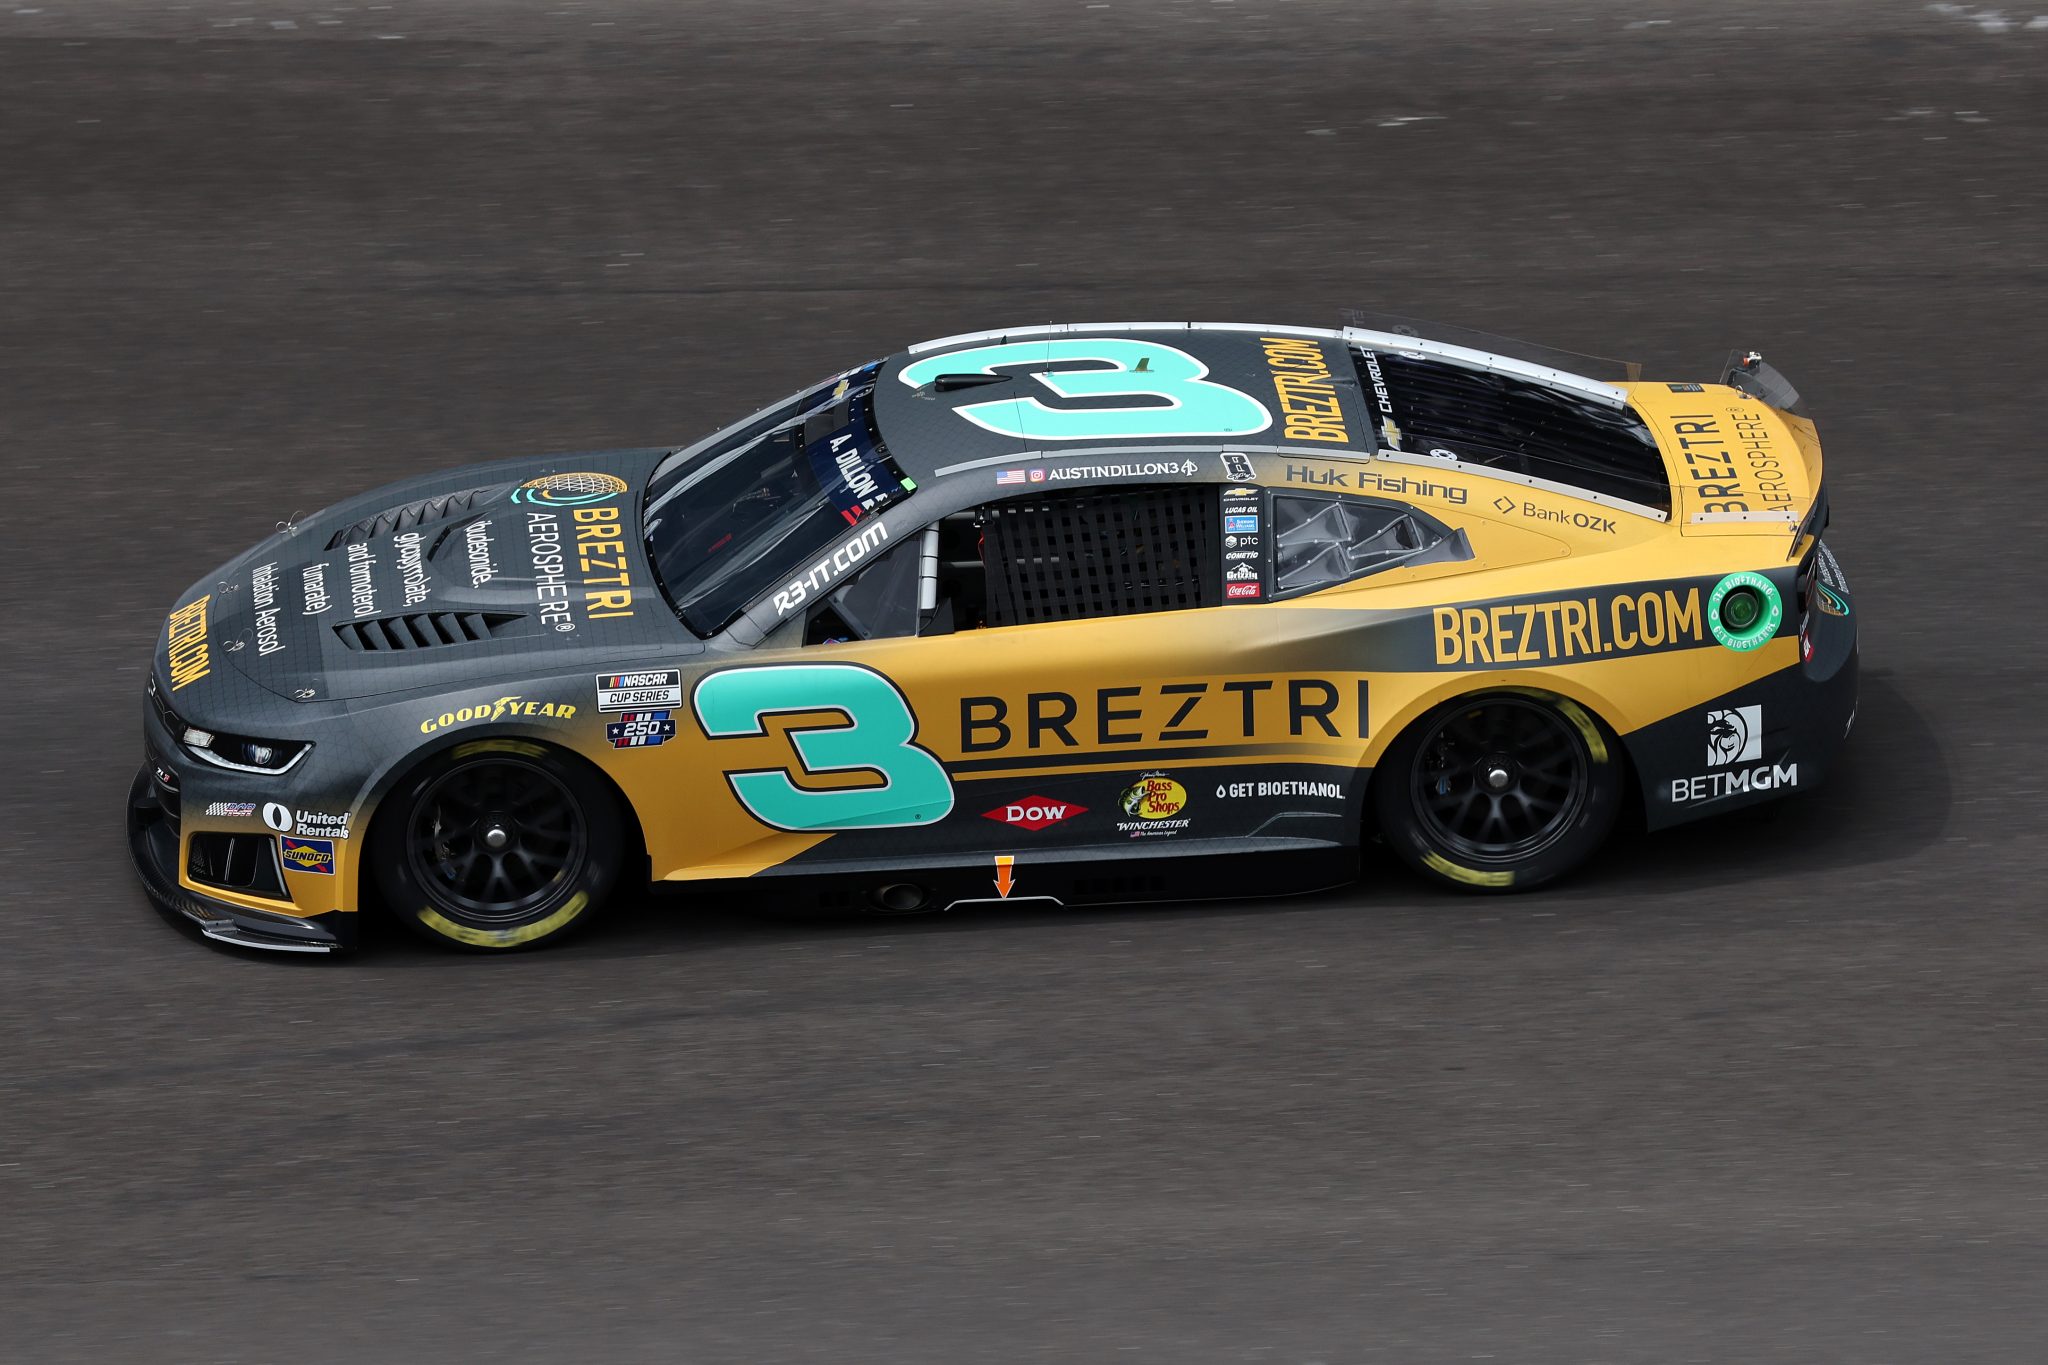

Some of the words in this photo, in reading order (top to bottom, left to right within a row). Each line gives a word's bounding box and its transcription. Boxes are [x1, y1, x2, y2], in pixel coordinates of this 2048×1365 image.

[898, 338, 1272, 441] 3
[1260, 337, 1349, 443] BREZTRI.COM
[1360, 346, 1392, 413] CHEVROLET
[830, 434, 852, 453] A.
[835, 448, 878, 498] DILLON
[1048, 462, 1179, 480] AUSTINDILLON3
[1670, 414, 1749, 513] BREZTRI
[1286, 465, 1349, 487] Huk
[1358, 472, 1468, 504] Fishing
[1523, 502, 1571, 525] Bank
[1572, 513, 1617, 534] OZK
[347, 543, 376, 562] and
[1240, 535, 1259, 547] ptc
[573, 507, 634, 619] BREZTRI
[773, 521, 888, 616] R3-IT.COM
[252, 562, 280, 609] Inhalation
[302, 563, 332, 616] fumarate)
[349, 559, 382, 618] formoterol
[1713, 587, 1725, 603] GET
[255, 607, 286, 656] Aerosol
[1433, 587, 1703, 665] BREZTRI.COM
[1714, 626, 1727, 640] GET
[624, 673, 668, 686] NASCAR
[609, 692, 631, 703] CUP
[632, 690, 669, 702] SERIES
[420, 696, 577, 734] GOODYEAR
[623, 722, 660, 736] 250
[960, 679, 1370, 754] BREZTRI
[694, 662, 954, 833] 3
[1147, 780, 1172, 791] Bass
[1147, 791, 1167, 801] Pro
[1229, 783, 1254, 799] GET
[1671, 763, 1798, 802] BETMGM
[295, 810, 349, 825] United
[1148, 801, 1180, 814] Shops
[295, 823, 349, 839] Rentals
[1117, 818, 1191, 831] WINCHESTER
[285, 849, 331, 863] SUNOCO
